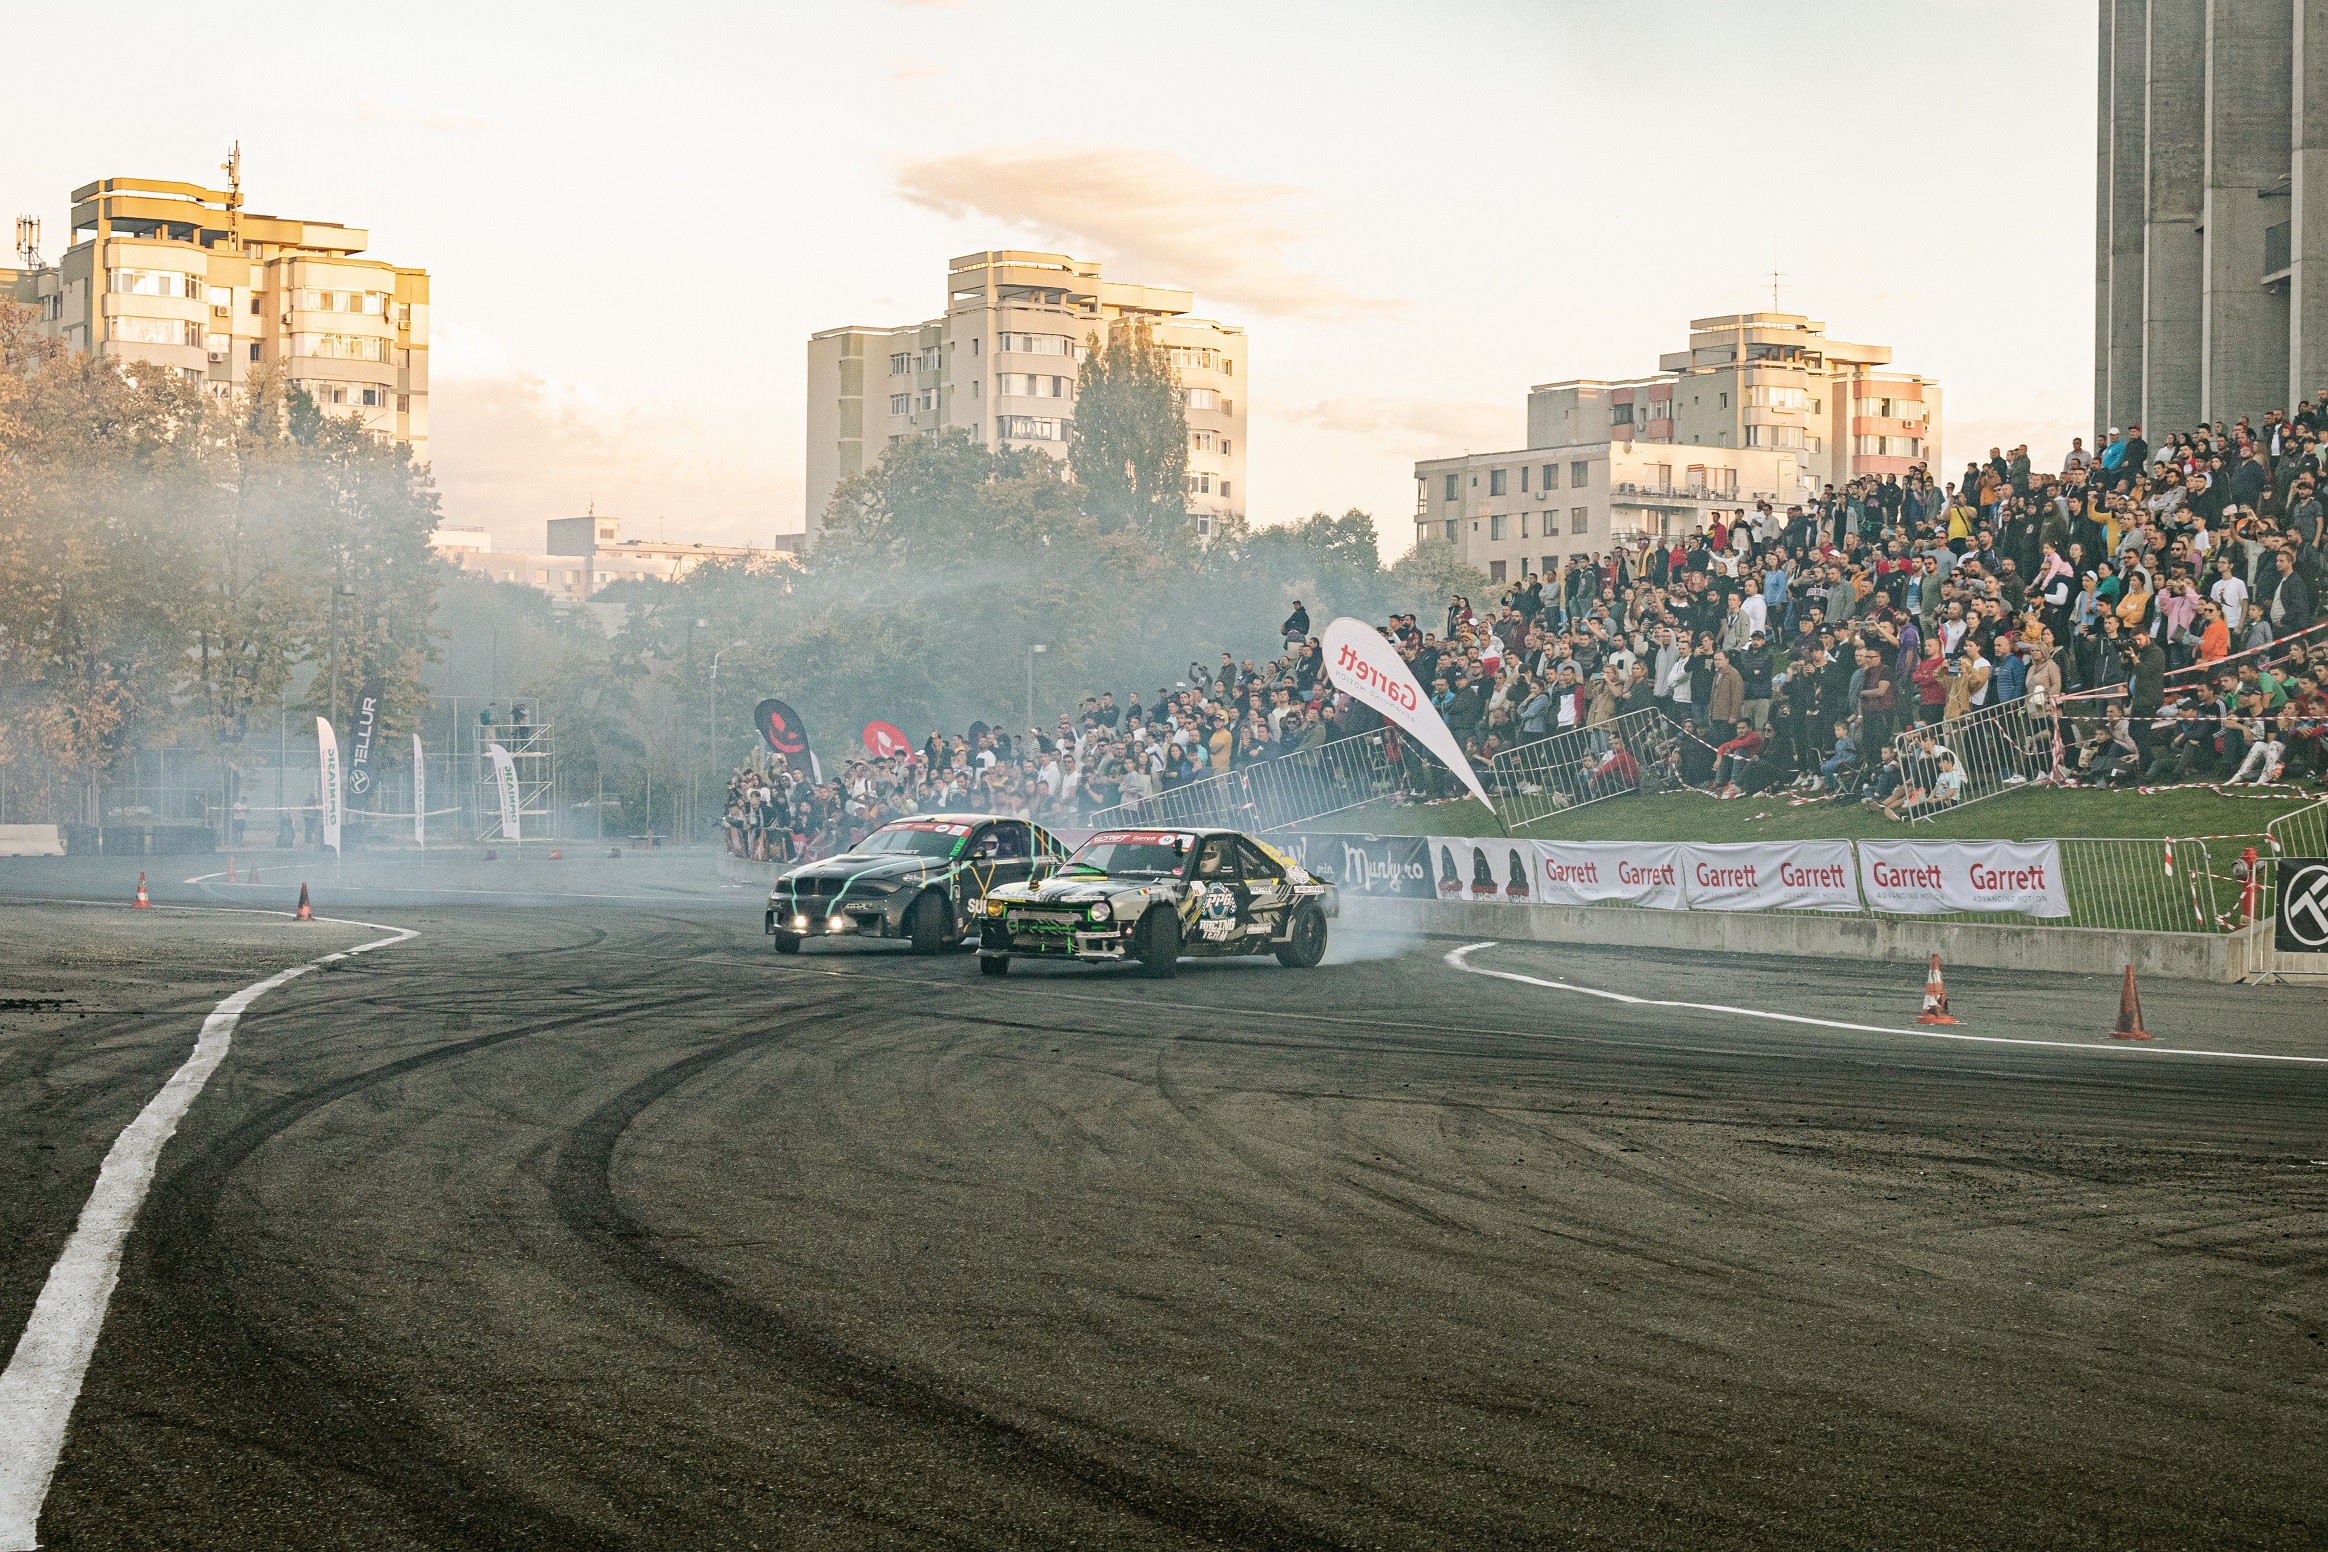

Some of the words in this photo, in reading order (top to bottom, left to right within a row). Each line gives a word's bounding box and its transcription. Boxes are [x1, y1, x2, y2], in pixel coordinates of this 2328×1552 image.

[354, 697, 377, 767] TELLUR
[1546, 858, 1599, 884] Garrett
[1618, 860, 1676, 886] Garrett
[1696, 862, 1758, 888] Garrett
[1780, 862, 1846, 889] Garrett
[1873, 861, 1942, 889] Garrett
[1969, 863, 2046, 890] Garrett
[1205, 893, 1233, 908] PPG
[1823, 892, 1847, 900] MOTION
[1877, 892, 1919, 900] ADVANCING
[1920, 893, 1946, 901] MOTION
[1973, 895, 2015, 903] ADVANCING
[2017, 895, 2048, 903] MOTION
[1199, 918, 1236, 931] RACING
[1203, 930, 1229, 941] TEAM
